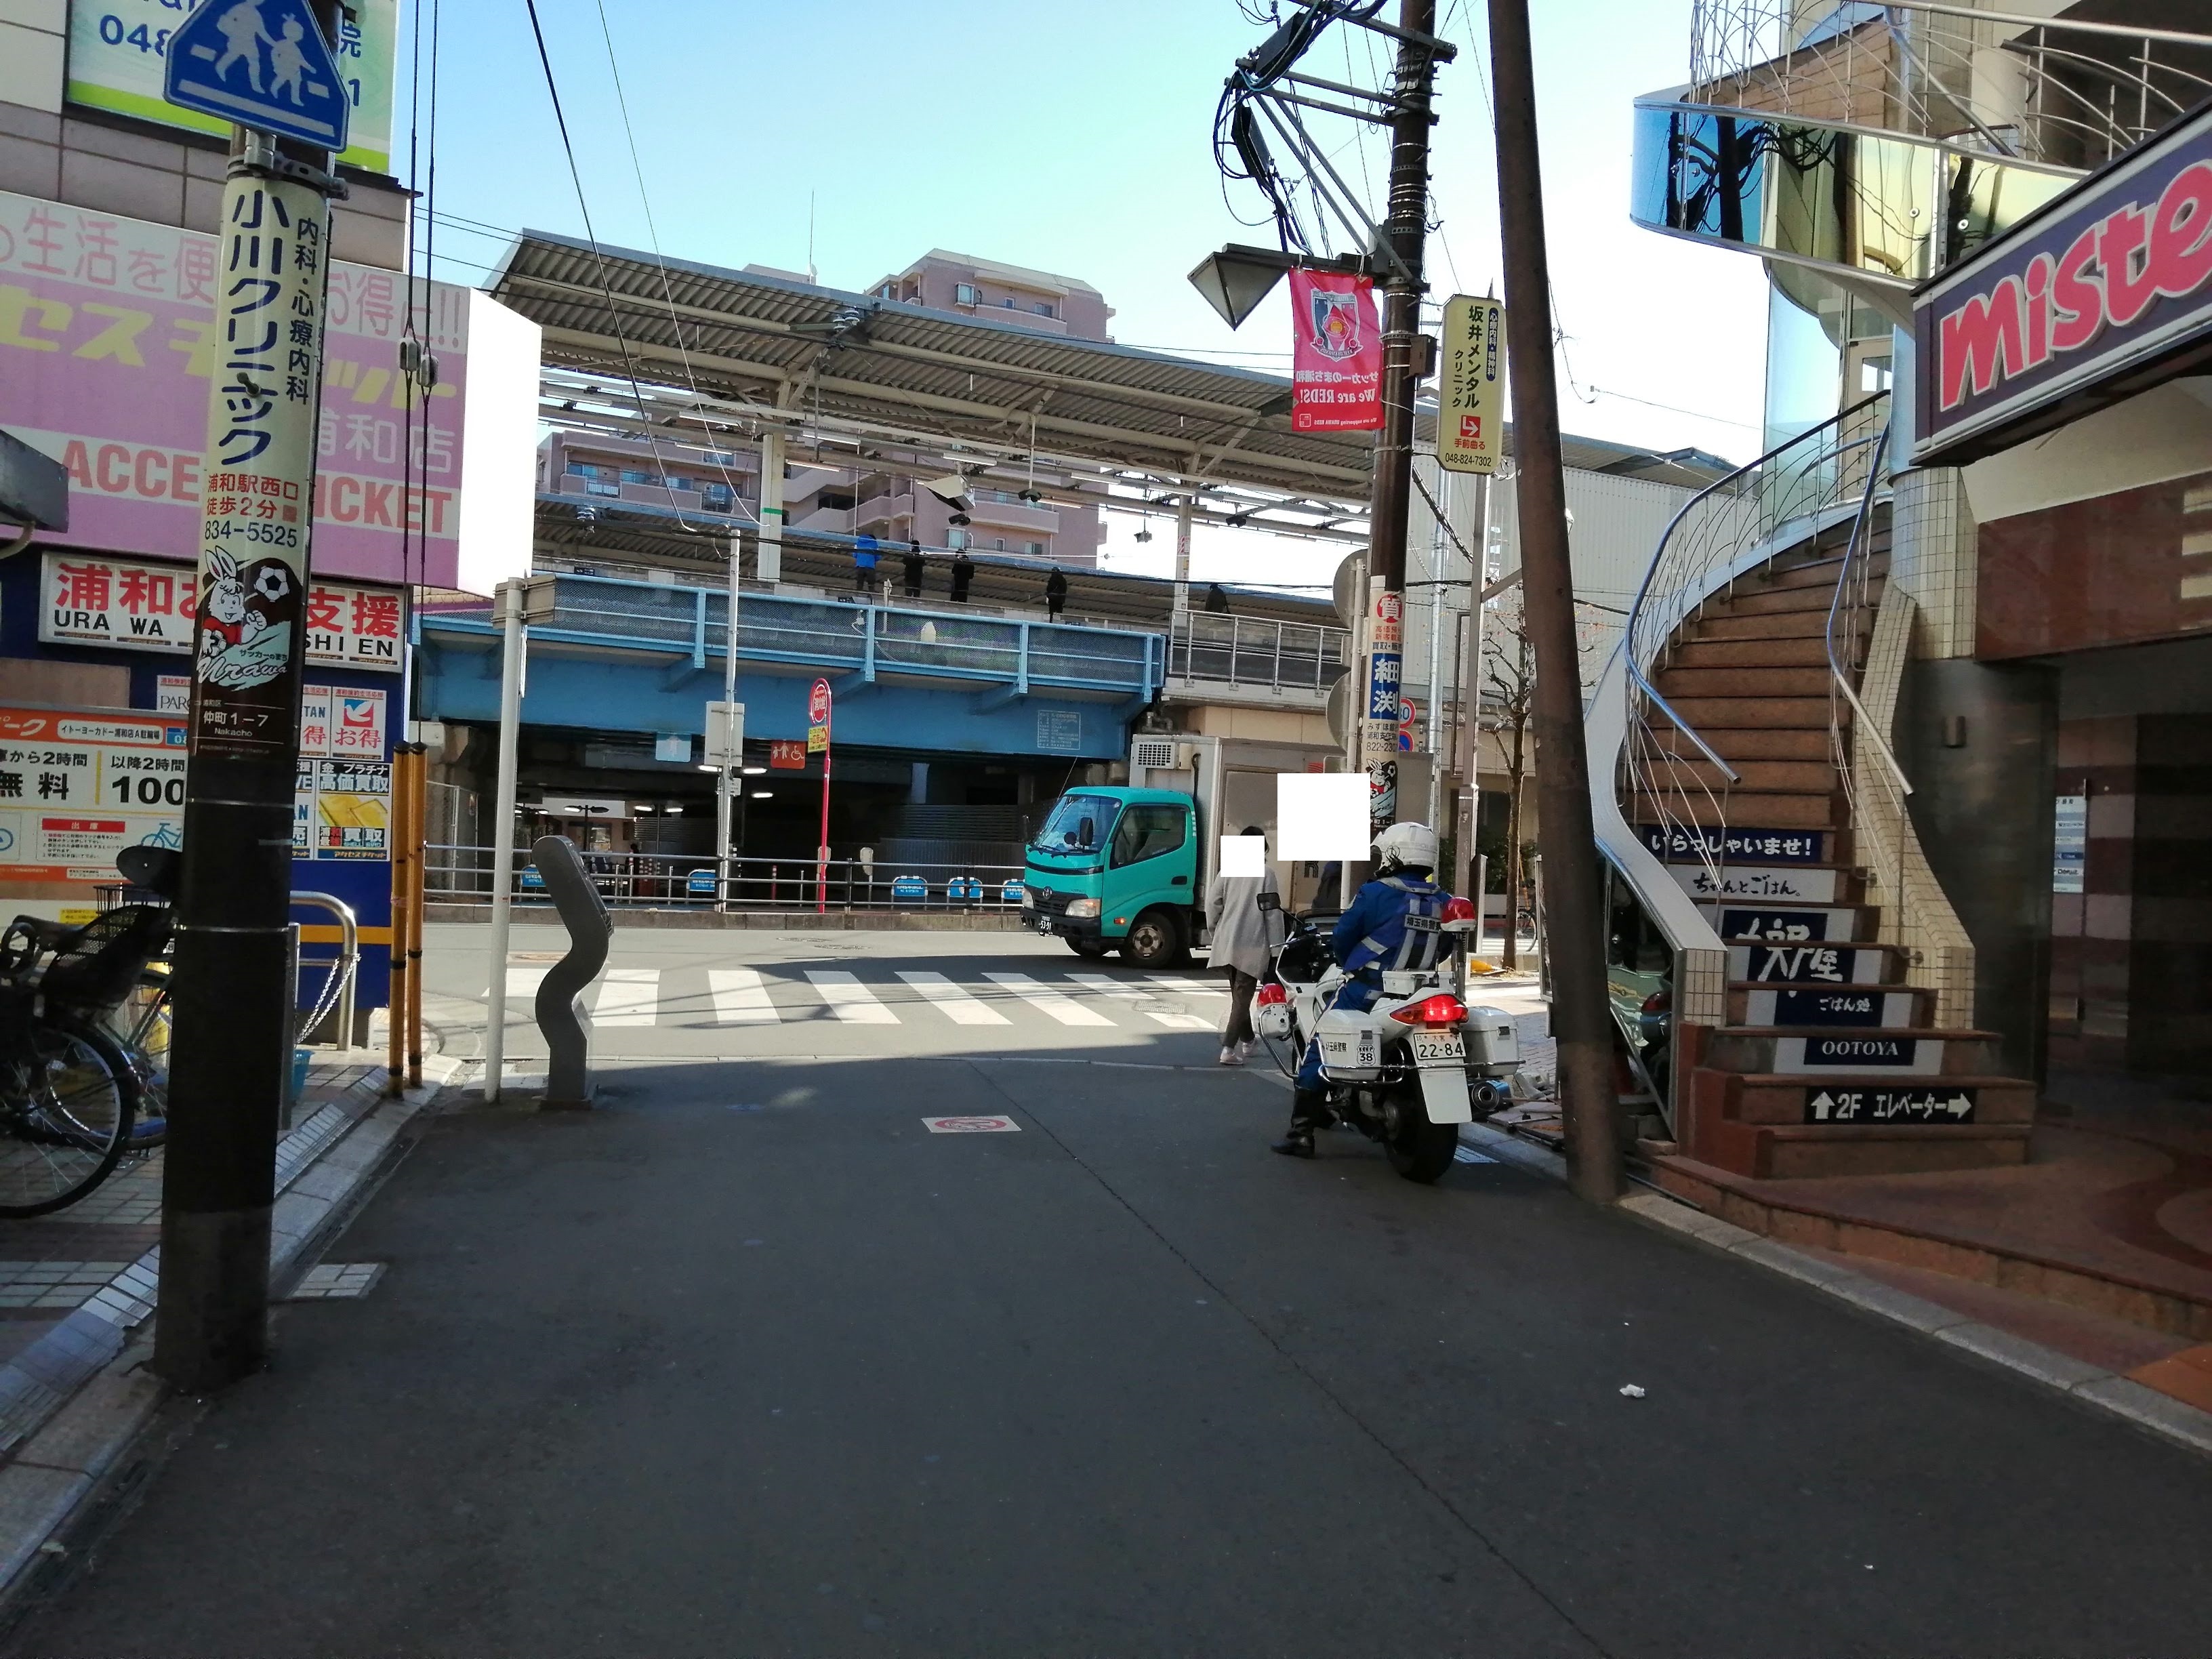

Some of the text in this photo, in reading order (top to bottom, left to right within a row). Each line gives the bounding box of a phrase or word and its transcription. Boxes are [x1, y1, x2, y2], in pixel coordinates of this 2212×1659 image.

[285, 217, 319, 406] 内科・心療内科
[218, 189, 289, 466] 小川クリニック
[1464, 305, 1484, 409] 坂井メンタル
[1452, 349, 1464, 408] クリニック
[1454, 438, 1486, 451] 手前曲る
[1445, 453, 1492, 468] 048-824-7302
[207, 473, 300, 501] 浦和駅西口
[206, 495, 278, 520] 徒歩2分
[204, 520, 298, 548] 834-5525
[0, 716, 47, 737] ーク
[213, 726, 253, 737] Nakacho
[334, 727, 382, 749] お得
[111, 755, 185, 772] 以降2時間
[321, 762, 388, 775] 金 プラチナ
[320, 773, 389, 792] 高価買取
[1651, 834, 1811, 856] いらっしゃいませ!
[1359, 1052, 1374, 1062] 38
[1822, 1040, 1898, 1056] OOTOYA
[1836, 1092, 1948, 1120] 2F エレベーター
